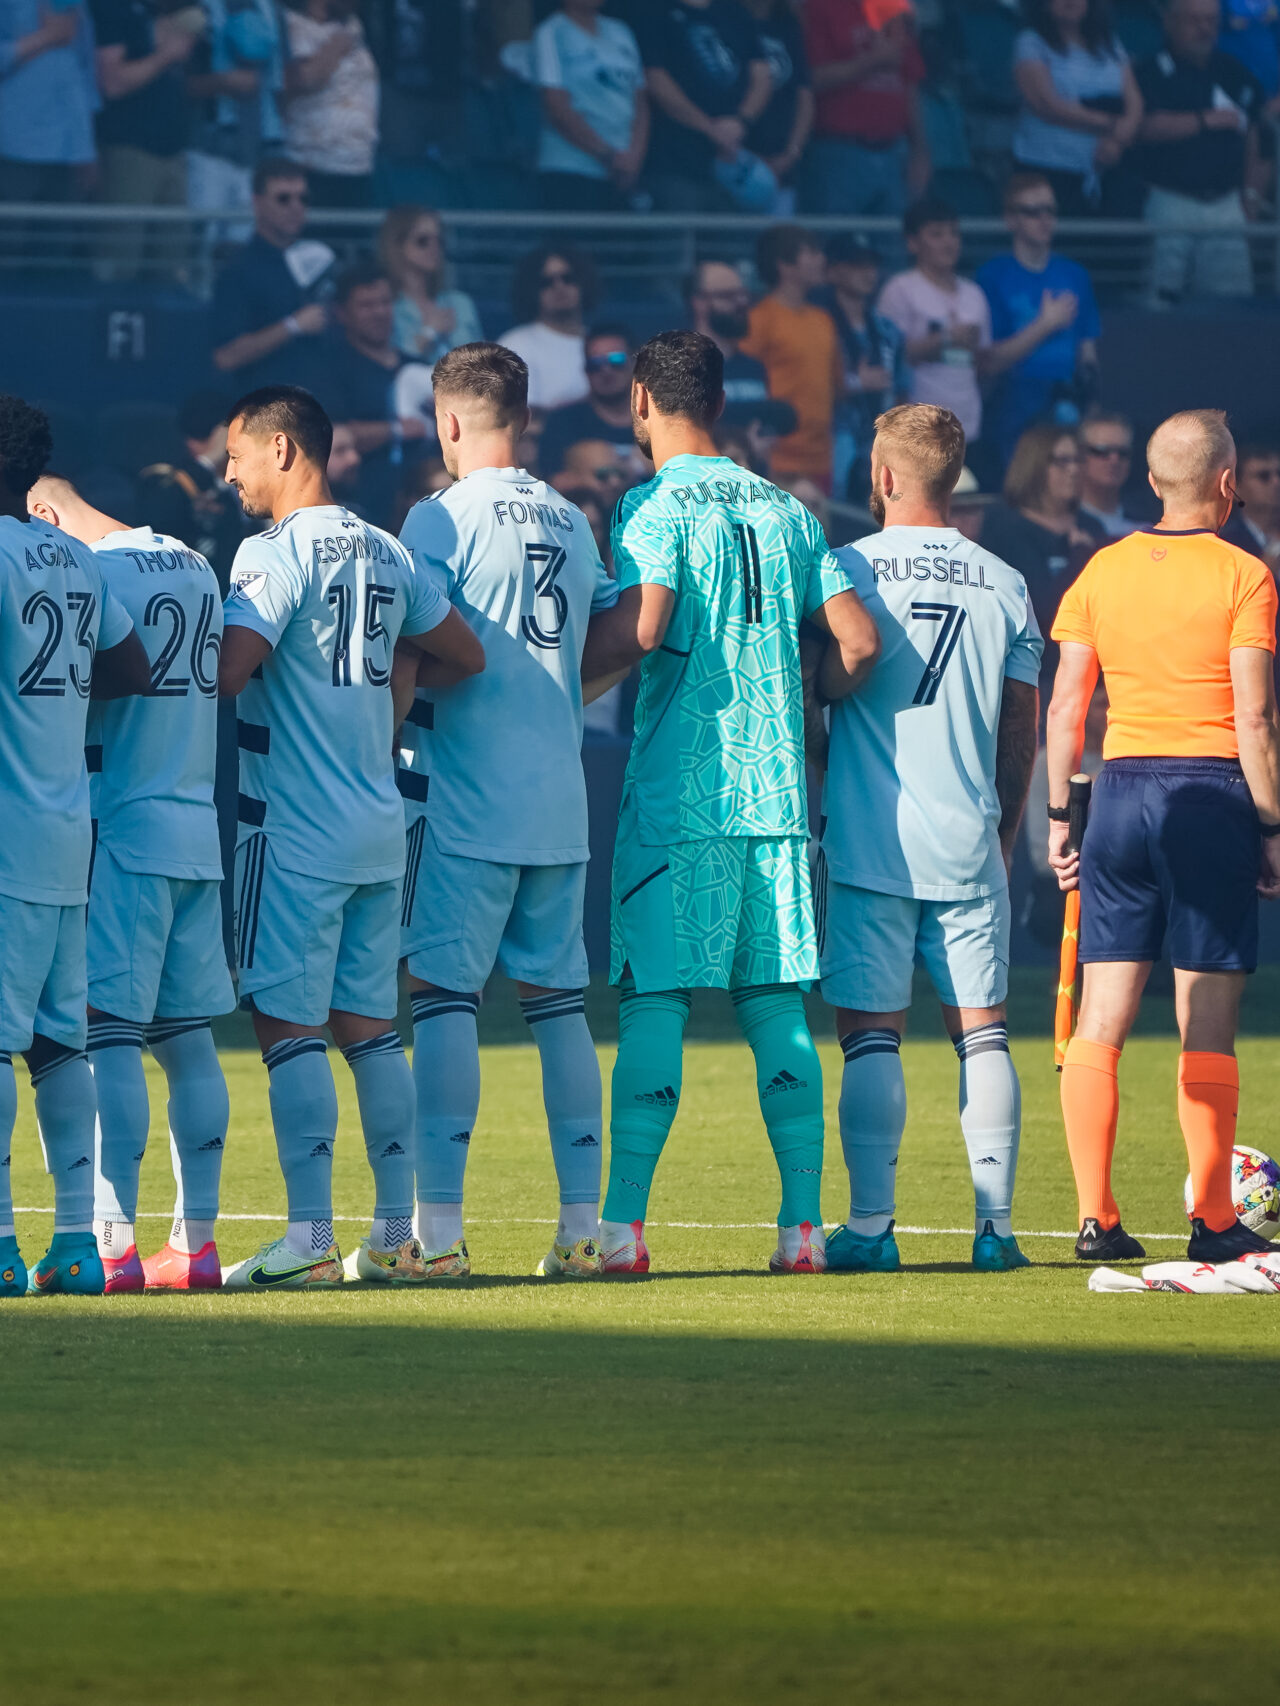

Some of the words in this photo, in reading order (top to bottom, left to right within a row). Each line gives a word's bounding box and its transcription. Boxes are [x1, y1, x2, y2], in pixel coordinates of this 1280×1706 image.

[493, 500, 575, 532] FONTAS
[521, 543, 568, 649] 3
[731, 523, 762, 624] 1
[872, 557, 995, 591] RUSSELL
[18, 590, 96, 698] 23
[142, 591, 220, 699] 26
[329, 584, 396, 688] 15
[911, 602, 967, 705] 7
